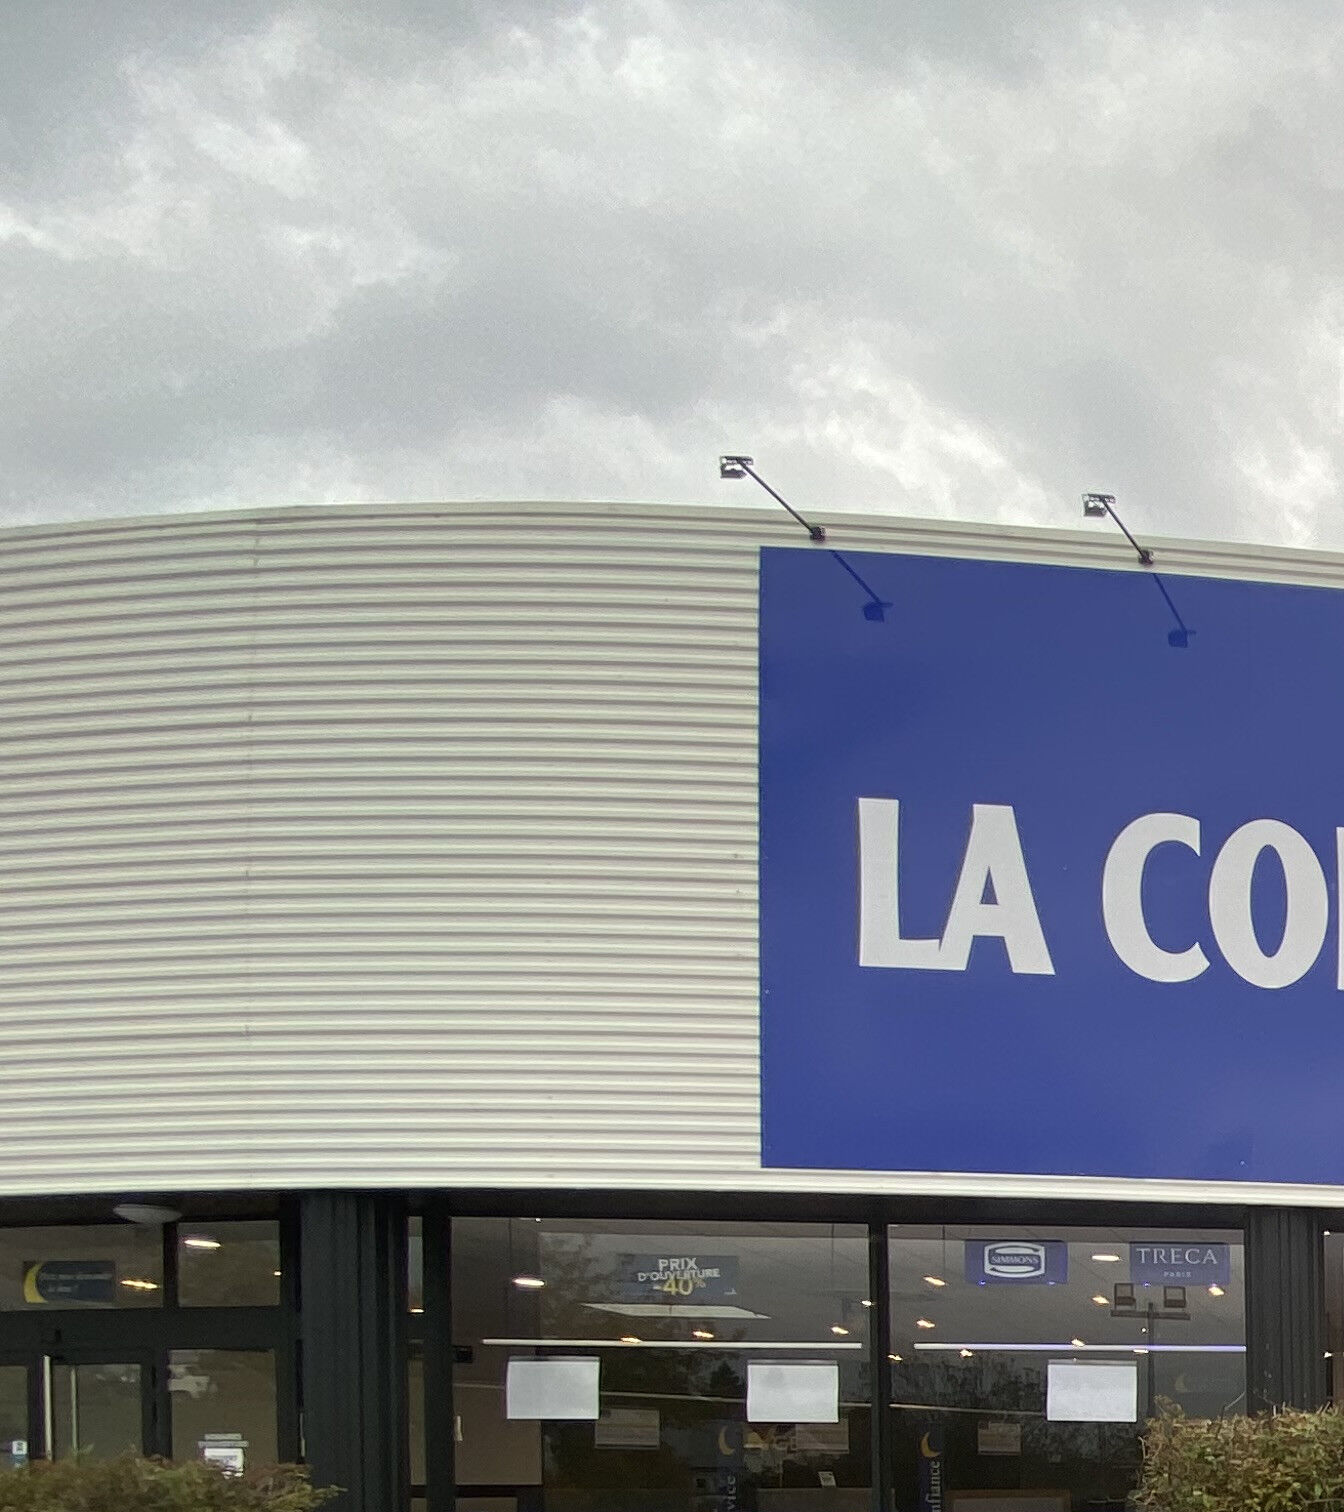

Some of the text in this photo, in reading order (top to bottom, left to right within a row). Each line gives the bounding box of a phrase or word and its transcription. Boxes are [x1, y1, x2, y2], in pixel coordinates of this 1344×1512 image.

[858, 796, 1056, 976] LA
[658, 1257, 698, 1271] PRIX
[1136, 1248, 1218, 1265] TRECA
